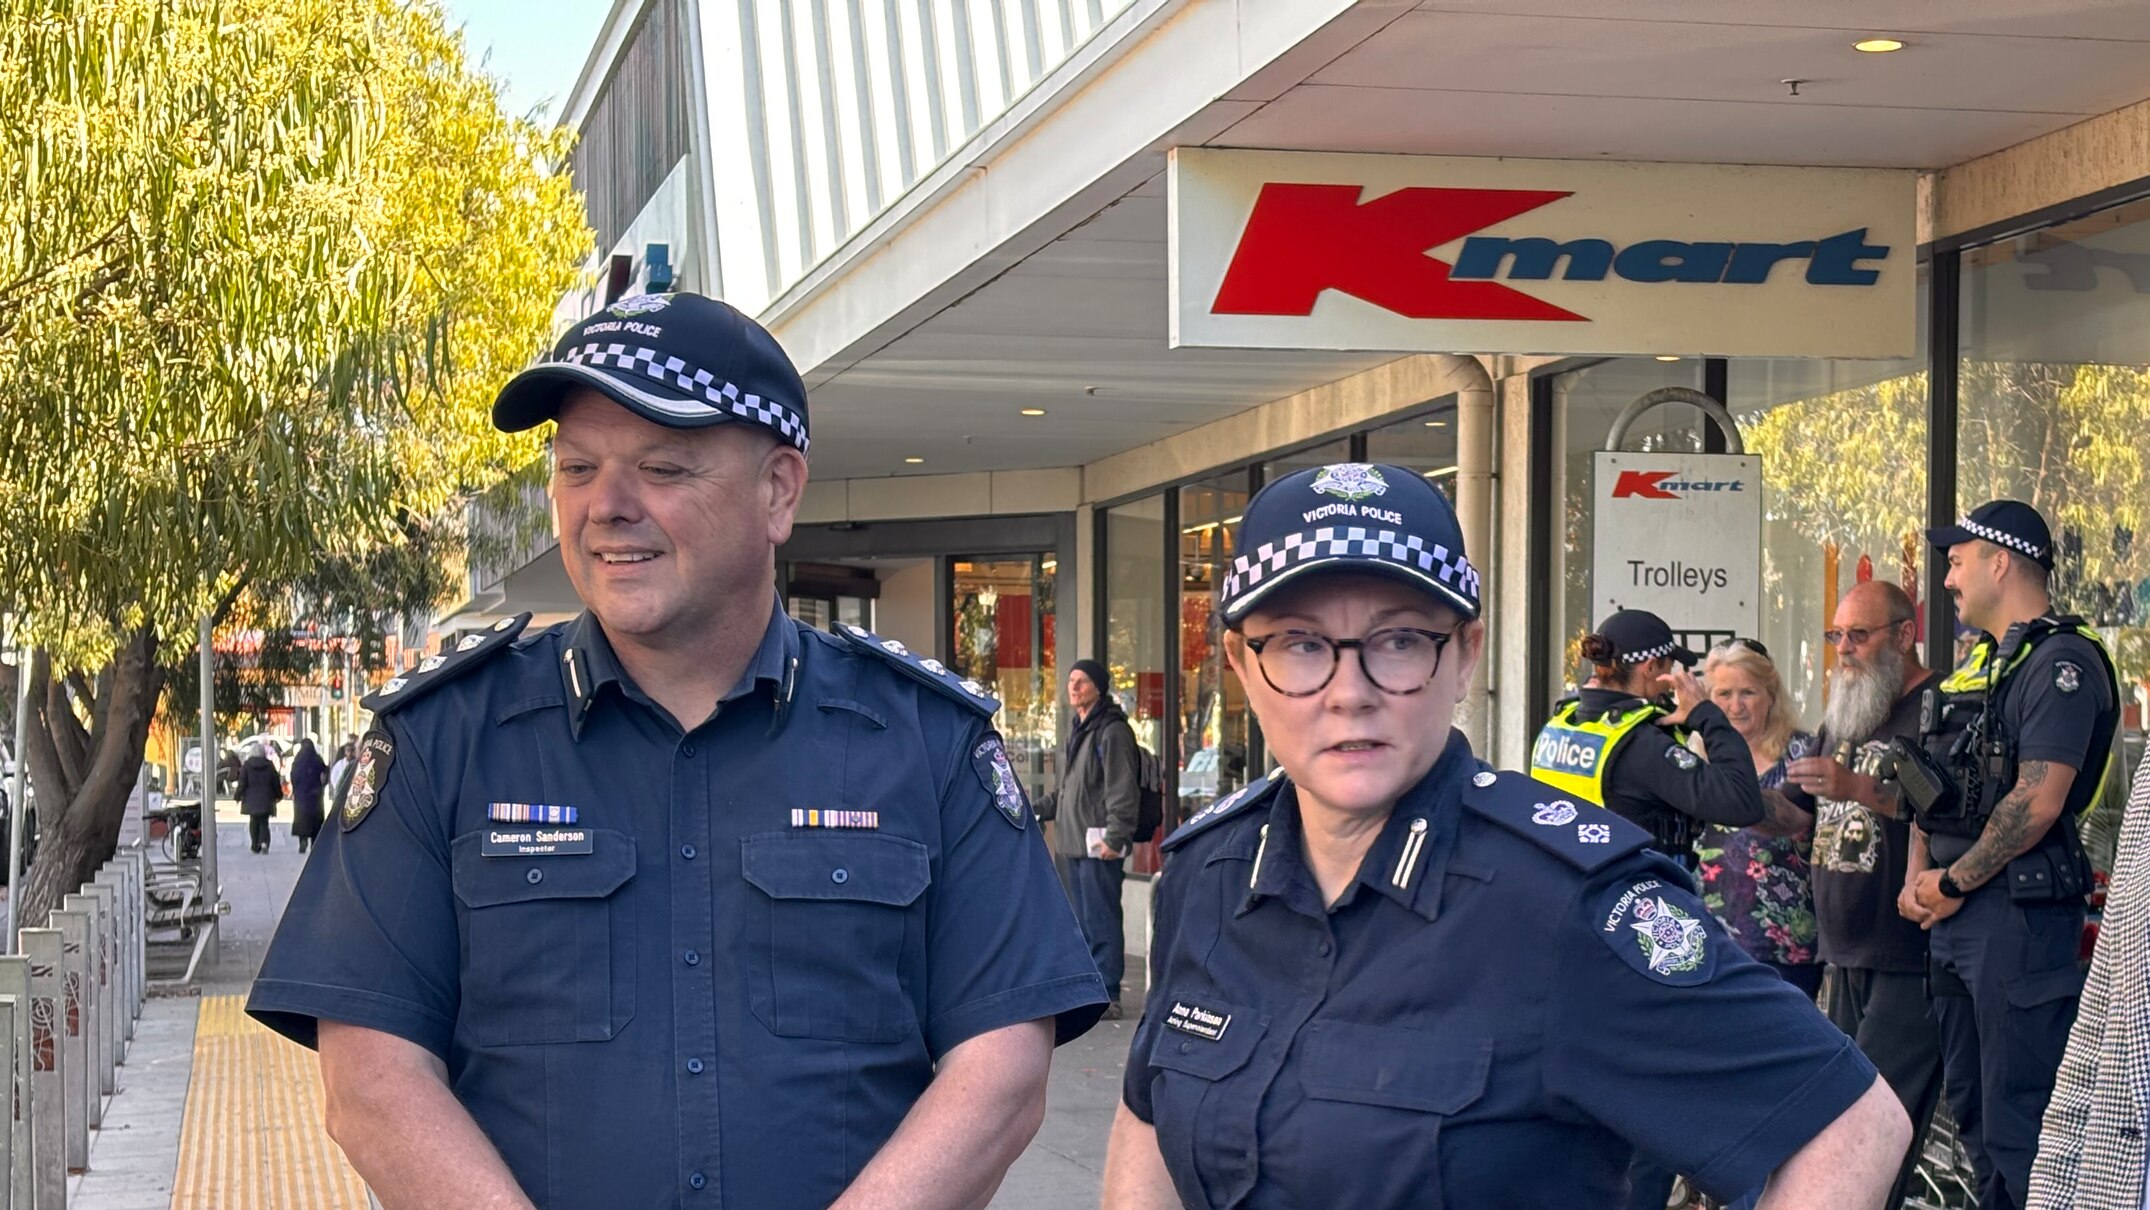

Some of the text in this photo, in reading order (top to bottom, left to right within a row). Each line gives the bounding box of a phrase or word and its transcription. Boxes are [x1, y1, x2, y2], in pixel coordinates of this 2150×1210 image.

[1210, 182, 1890, 322] Kmart
[583, 321, 662, 338] VICTORIA POLICE
[1612, 470, 1744, 499] Kmart
[1303, 503, 1402, 525] VICTORIA POLICE
[1627, 560, 1728, 594] Trolleys
[372, 738, 393, 756] POLICE
[1535, 734, 1596, 769] Police
[490, 830, 584, 844] Cameron Sanderson
[518, 845, 555, 854] Inspector
[1604, 880, 1662, 932] VICTORIA POLICE
